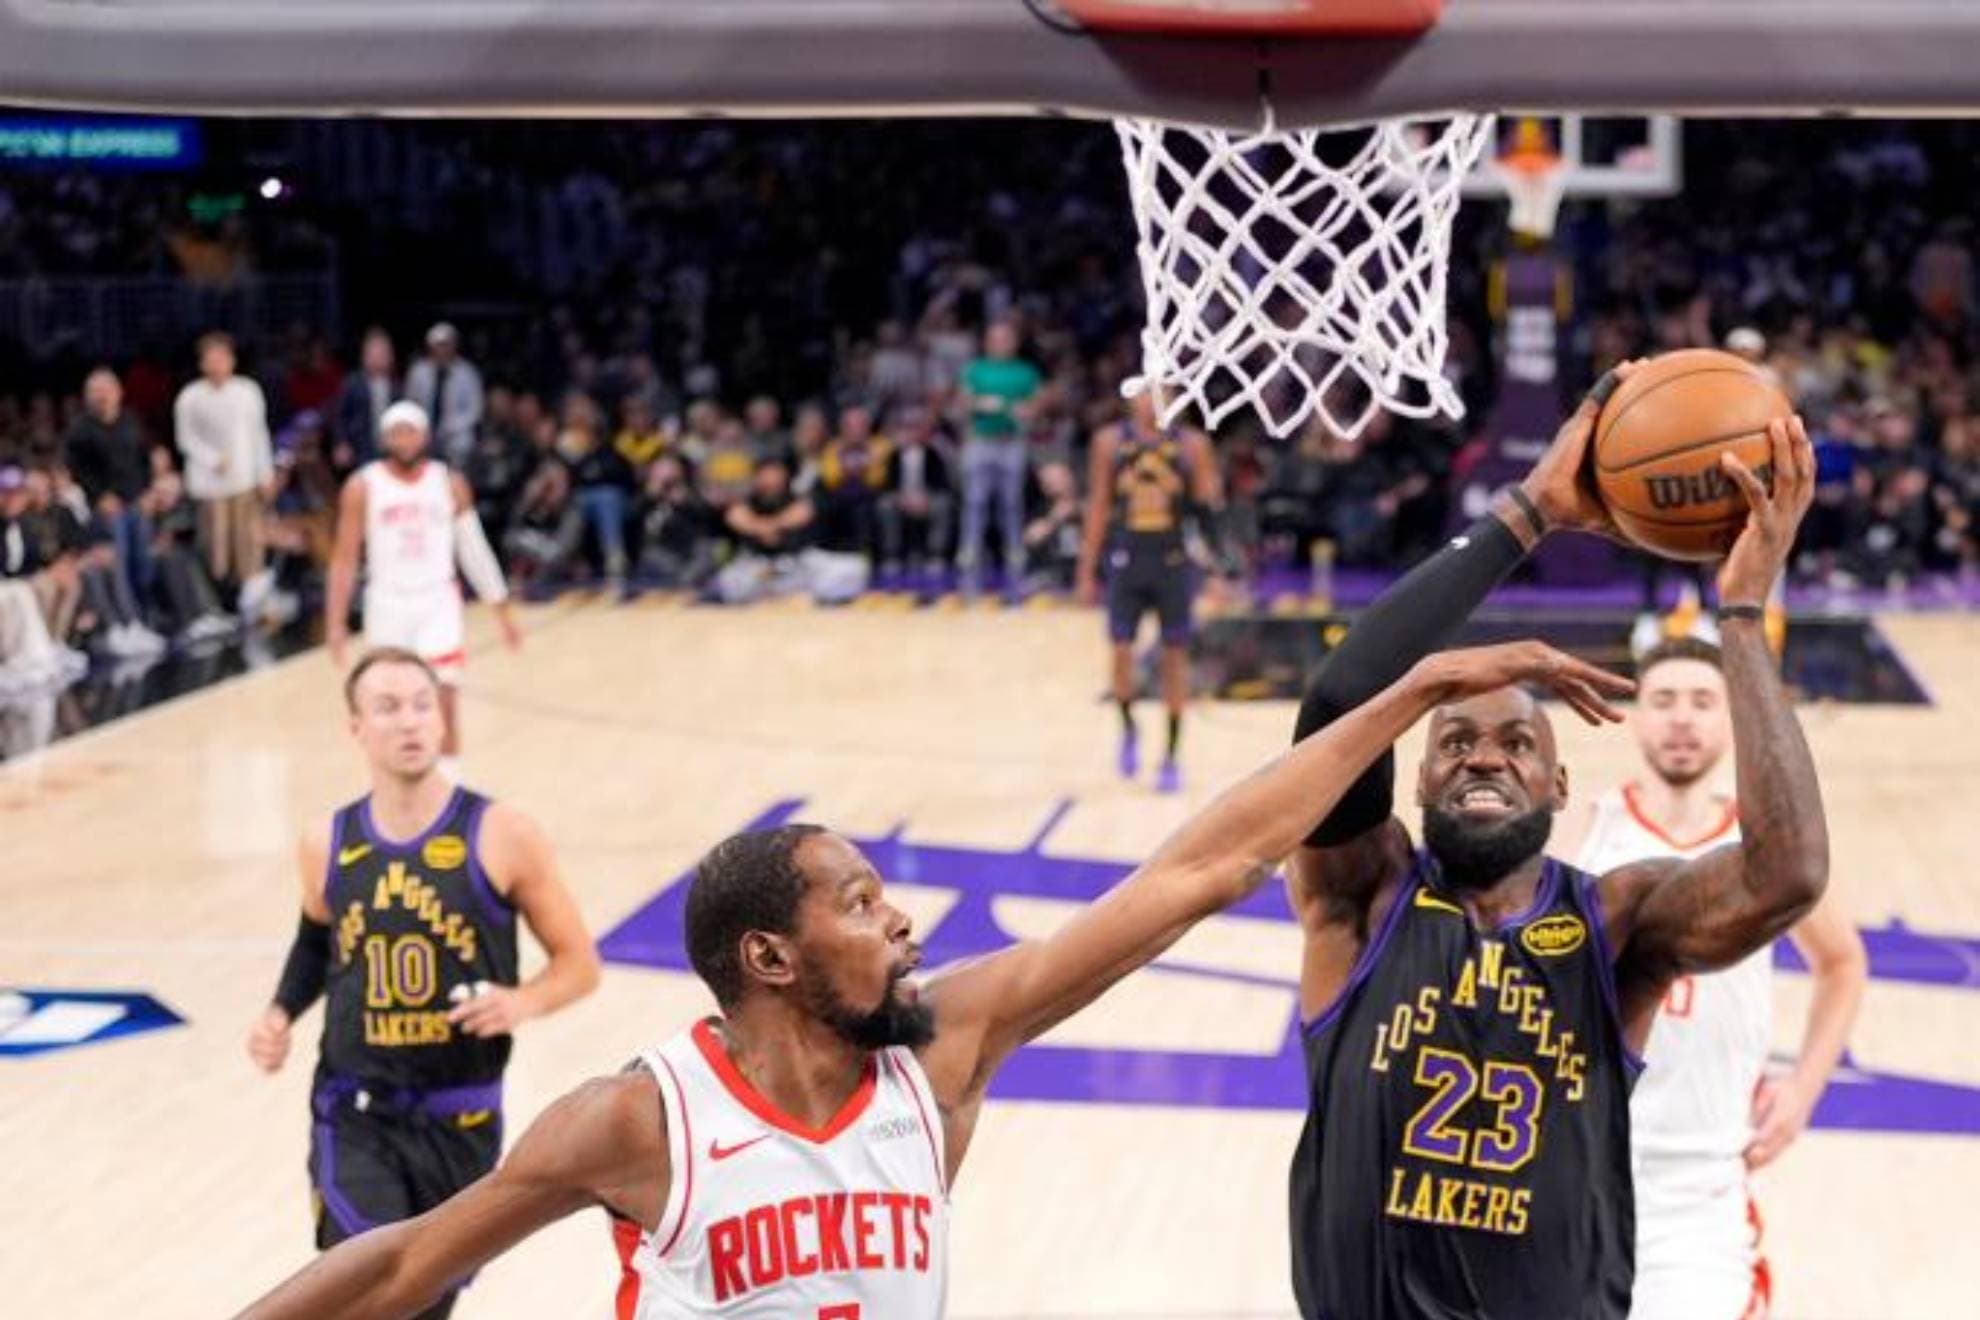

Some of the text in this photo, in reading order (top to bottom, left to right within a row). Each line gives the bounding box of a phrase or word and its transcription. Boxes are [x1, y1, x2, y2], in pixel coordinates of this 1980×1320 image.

[373, 861, 476, 962] ANGELES
[365, 933, 437, 1007] 10
[365, 1009, 450, 1046] LAKERS
[1371, 940, 1586, 1102] LOS ANGELES
[1402, 1045, 1544, 1173] 23
[706, 1190, 932, 1304] ROCKETS
[1386, 1168, 1531, 1235] LAKERS
